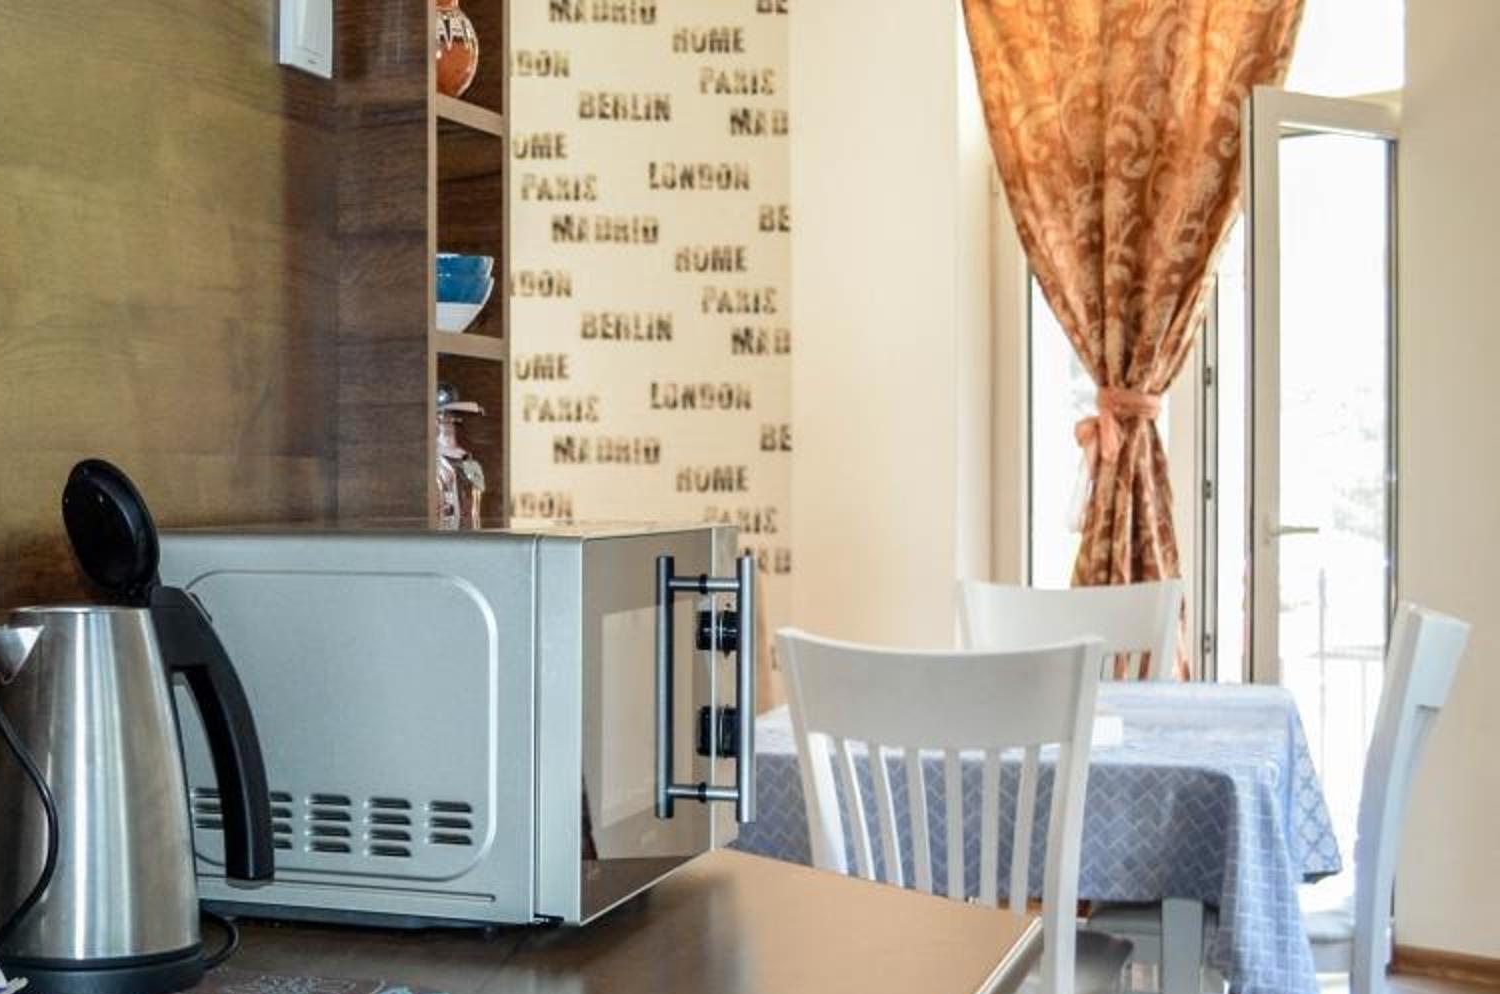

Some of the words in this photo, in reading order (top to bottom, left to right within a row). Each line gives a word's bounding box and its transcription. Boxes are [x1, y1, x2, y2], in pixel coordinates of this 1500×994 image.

[549, 0, 657, 24] MADRID
[511, 50, 570, 77] DON
[700, 66, 775, 96] PARIS
[578, 91, 671, 122] BERLIN
[730, 108, 789, 137] MAD
[513, 133, 567, 160] OME
[520, 172, 598, 201] PARIS
[649, 161, 751, 191] LONDON
[551, 214, 660, 244] MADRID
[758, 205, 791, 232] BE
[511, 271, 572, 298] DON
[702, 286, 778, 315] PARIS
[580, 311, 673, 342] BERLIN
[731, 326, 791, 356] MAD
[515, 354, 570, 381] OME
[522, 395, 600, 423] PARIS
[650, 381, 752, 411] LONDON
[553, 436, 661, 465] MADRID
[760, 424, 793, 452] BE
[511, 491, 572, 519] DON
